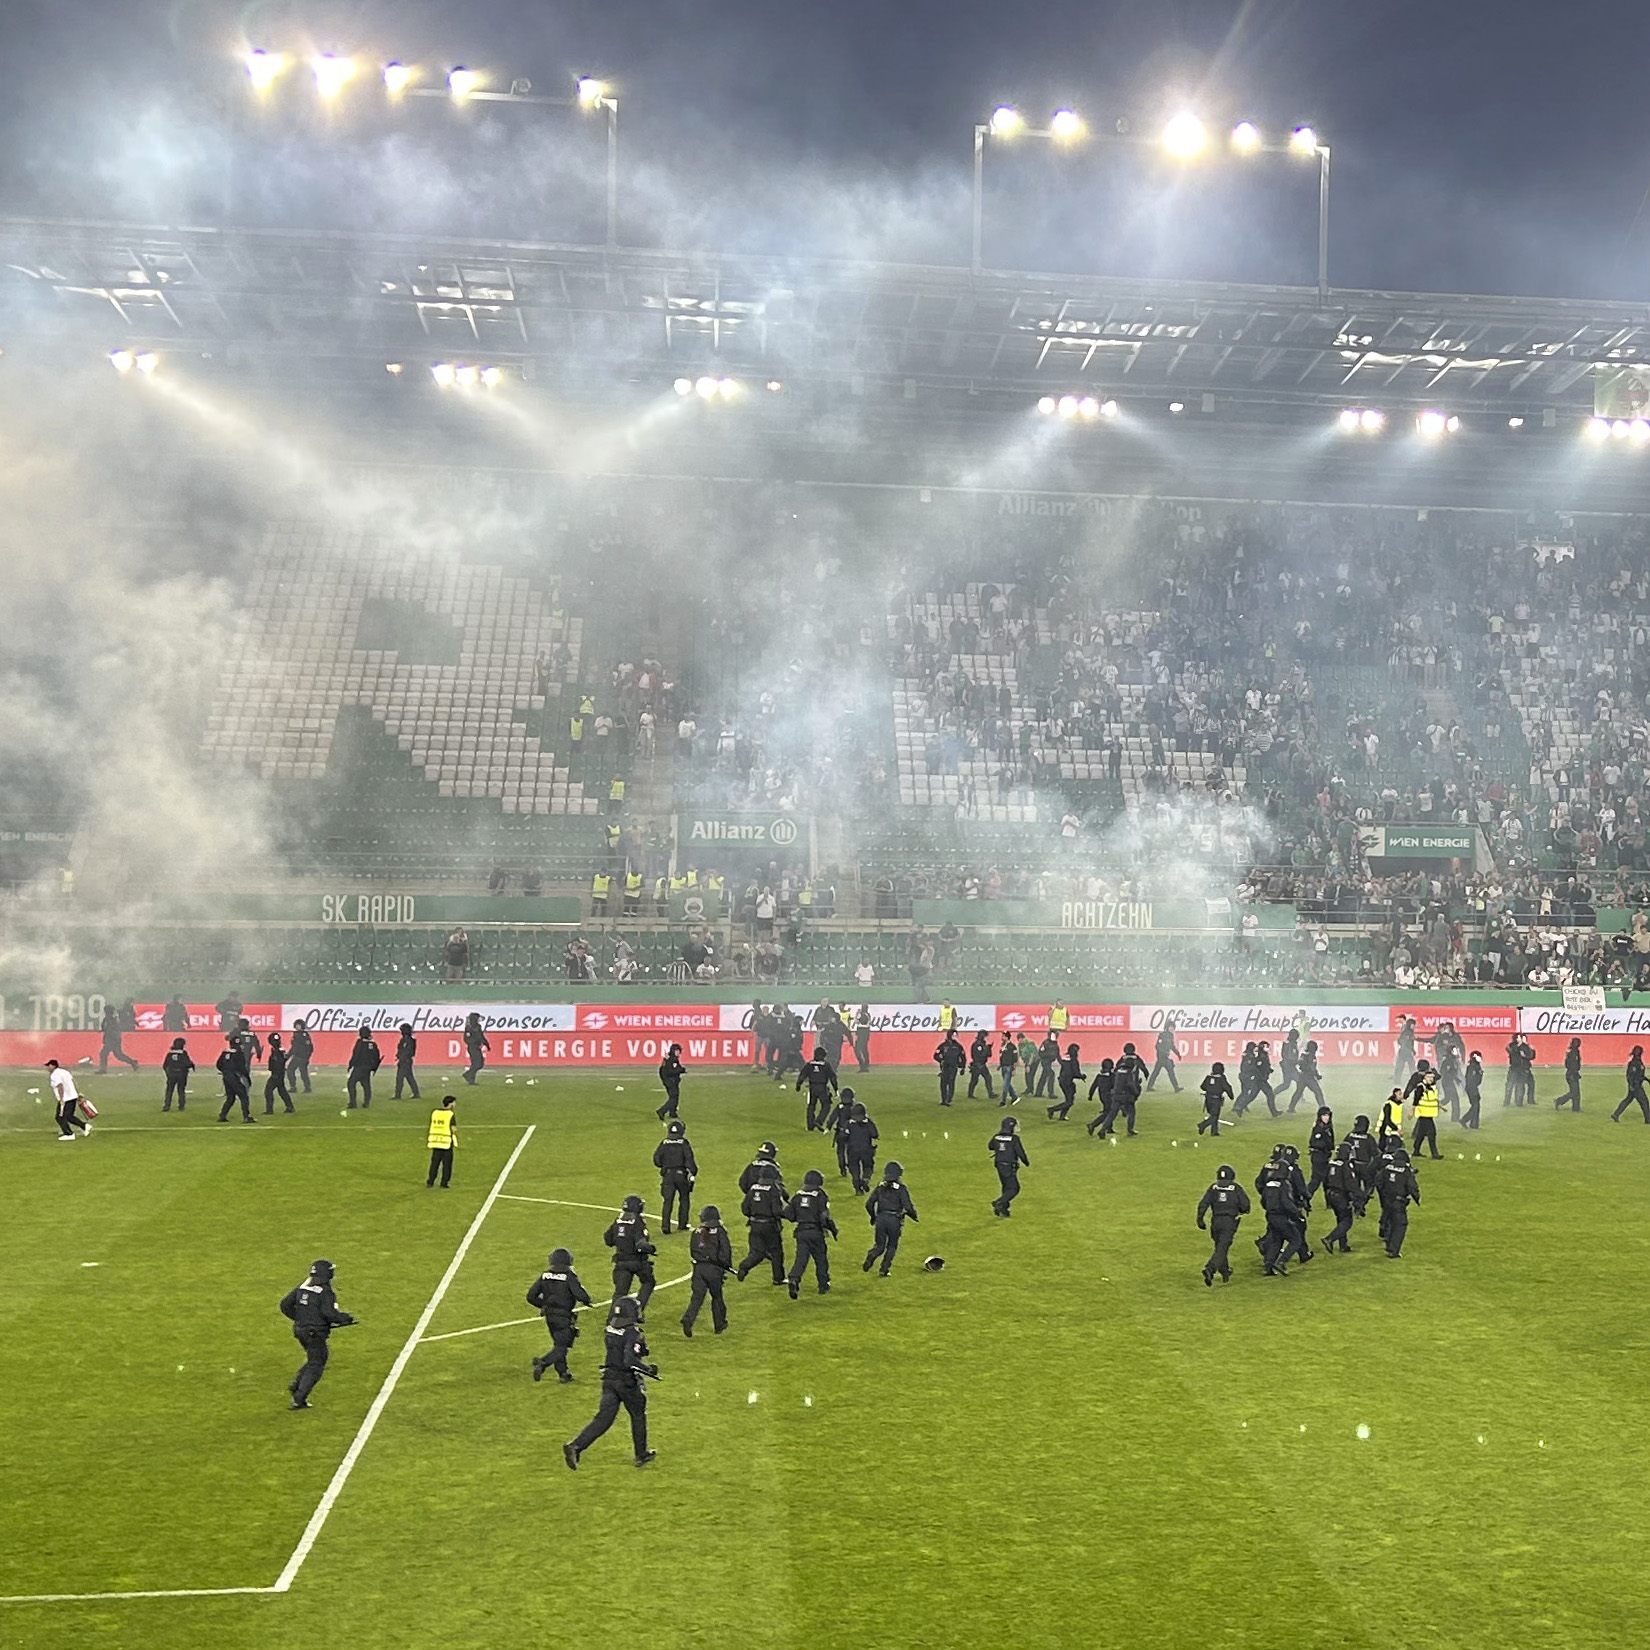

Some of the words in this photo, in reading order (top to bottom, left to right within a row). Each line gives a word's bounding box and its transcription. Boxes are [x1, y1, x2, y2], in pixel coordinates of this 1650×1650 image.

[691, 820, 766, 840] Allianz
[1389, 837, 1420, 847] WIEN
[1422, 838, 1471, 848] ENERGIE
[322, 894, 348, 923] SK
[358, 894, 415, 923] RAPID
[1061, 902, 1153, 928] ACHTZEHN
[29, 994, 106, 1030] 1899
[305, 1008, 404, 1032] Offizieller
[410, 1007, 557, 1032] Haupponsor.
[613, 1015, 653, 1027] WIEN
[655, 1015, 713, 1027] ENERGIE
[1031, 1015, 1049, 1026] WI
[1069, 1015, 1124, 1027] ENERGIE
[1243, 1008, 1373, 1032] Hauptponsor.
[1458, 1017, 1512, 1029] ENERGIE
[1536, 1011, 1620, 1033] Offizieller
[503, 1039, 612, 1058] ENERGIE
[688, 1039, 749, 1058] WIEN
[1178, 1039, 1213, 1057] DIE
[1338, 1039, 1380, 1058] VON
